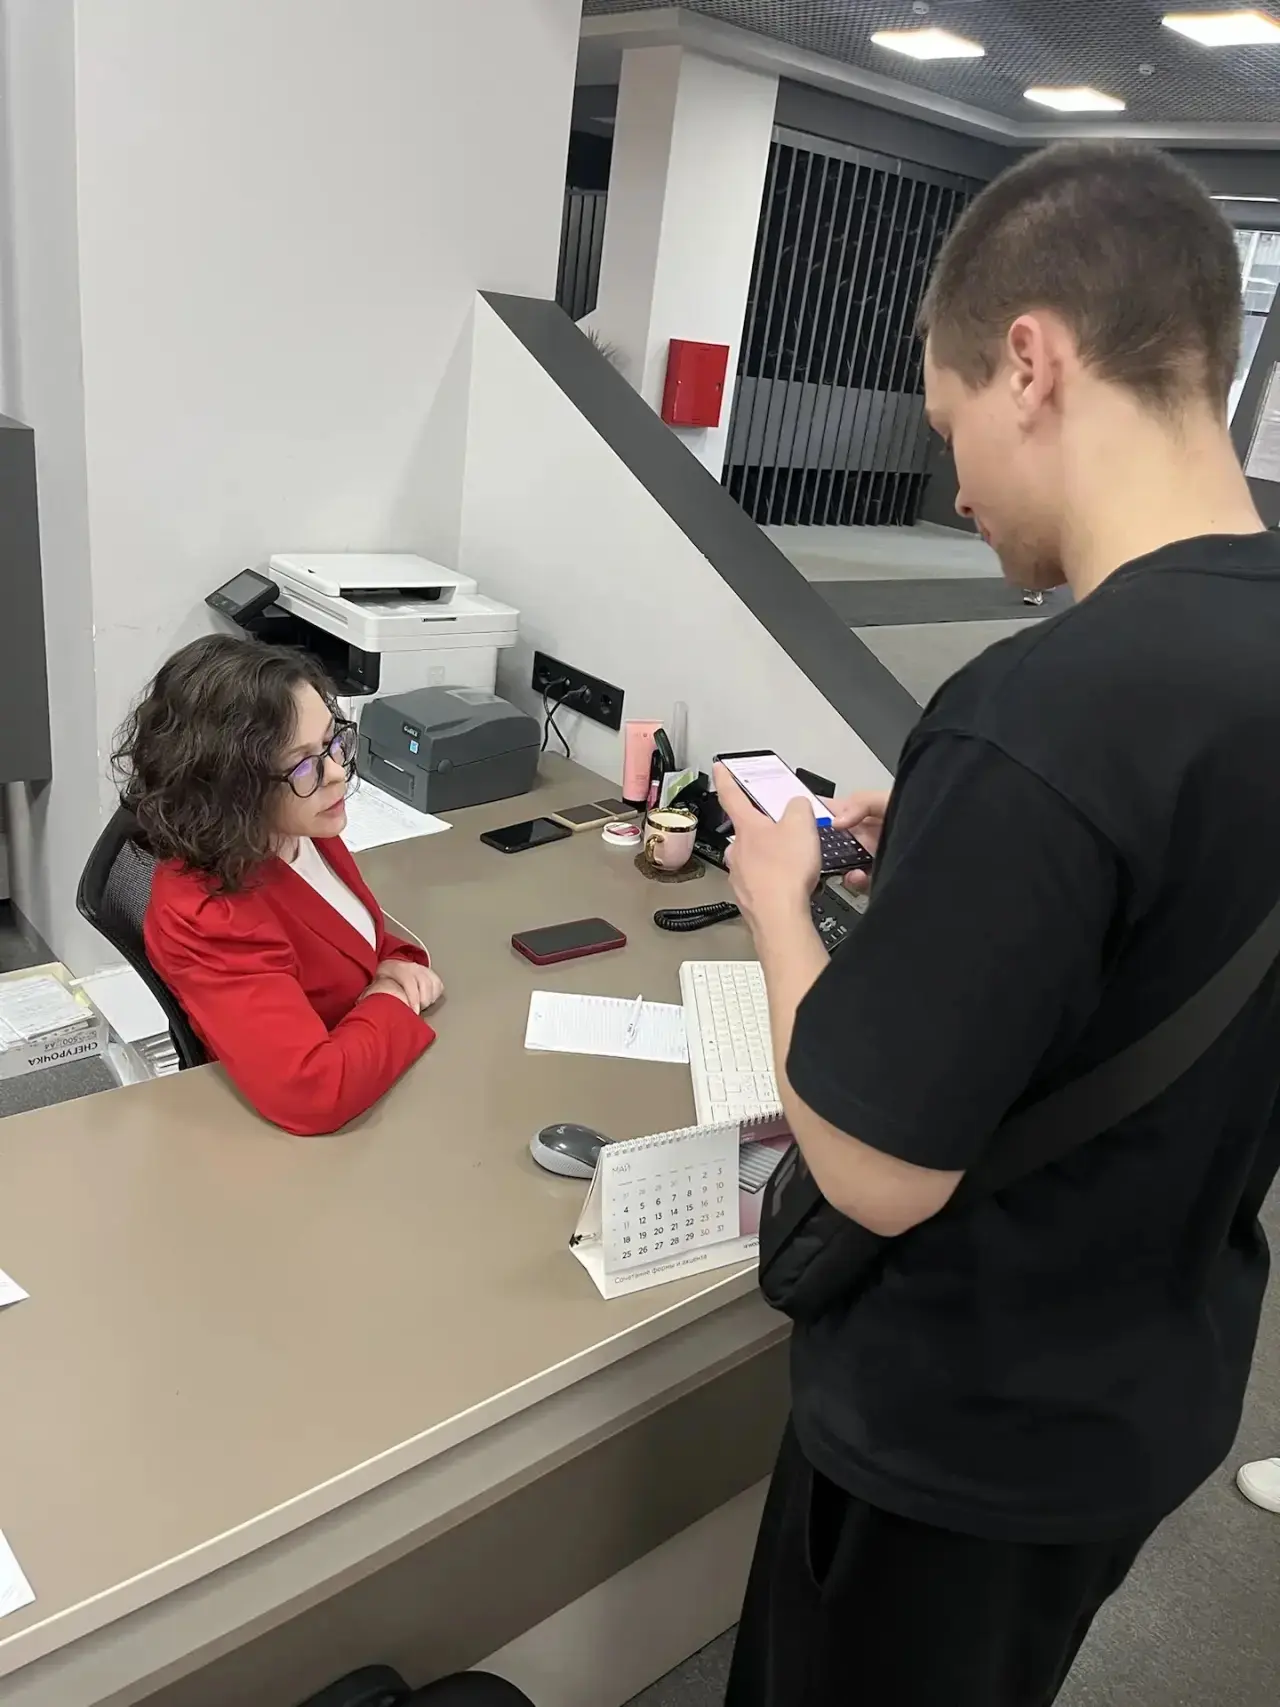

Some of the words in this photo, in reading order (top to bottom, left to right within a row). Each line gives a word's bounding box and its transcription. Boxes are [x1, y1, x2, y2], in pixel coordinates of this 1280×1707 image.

[28, 1042, 98, 1066] СНЕГУРОЧКА
[62, 1036, 79, 1046] 500
[612, 1162, 631, 1175] МАЙ
[687, 1175, 692, 1183] 1
[623, 1205, 629, 1213] 4
[639, 1201, 646, 1209] 5
[655, 1197, 662, 1205] 6
[671, 1193, 677, 1201] 7
[686, 1189, 693, 1197] 8
[701, 1185, 708, 1193] 9
[716, 1181, 725, 1189] 10
[623, 1221, 630, 1230] 11
[639, 1216, 647, 1224] 12
[656, 1212, 663, 1220] 13
[671, 1208, 679, 1216] 14
[686, 1203, 694, 1211] 15
[701, 1199, 709, 1207] 16
[717, 1195, 724, 1203] 17
[623, 1235, 631, 1243] 18
[639, 1231, 648, 1239] 19
[654, 1227, 665, 1235] 20
[671, 1223, 679, 1231] 21
[686, 1218, 695, 1226] 22
[700, 1214, 710, 1222] 23
[716, 1210, 725, 1218] 24
[623, 1251, 632, 1259] 25
[639, 1246, 649, 1254] 26
[655, 1242, 664, 1250] 27
[670, 1237, 680, 1245] 28
[686, 1233, 695, 1241] 29
[700, 1228, 711, 1236] 30
[717, 1224, 725, 1232] 31
[614, 1269, 651, 1285] Сочетание
[651, 1262, 676, 1276] формы
[682, 1254, 708, 1267] акцента
